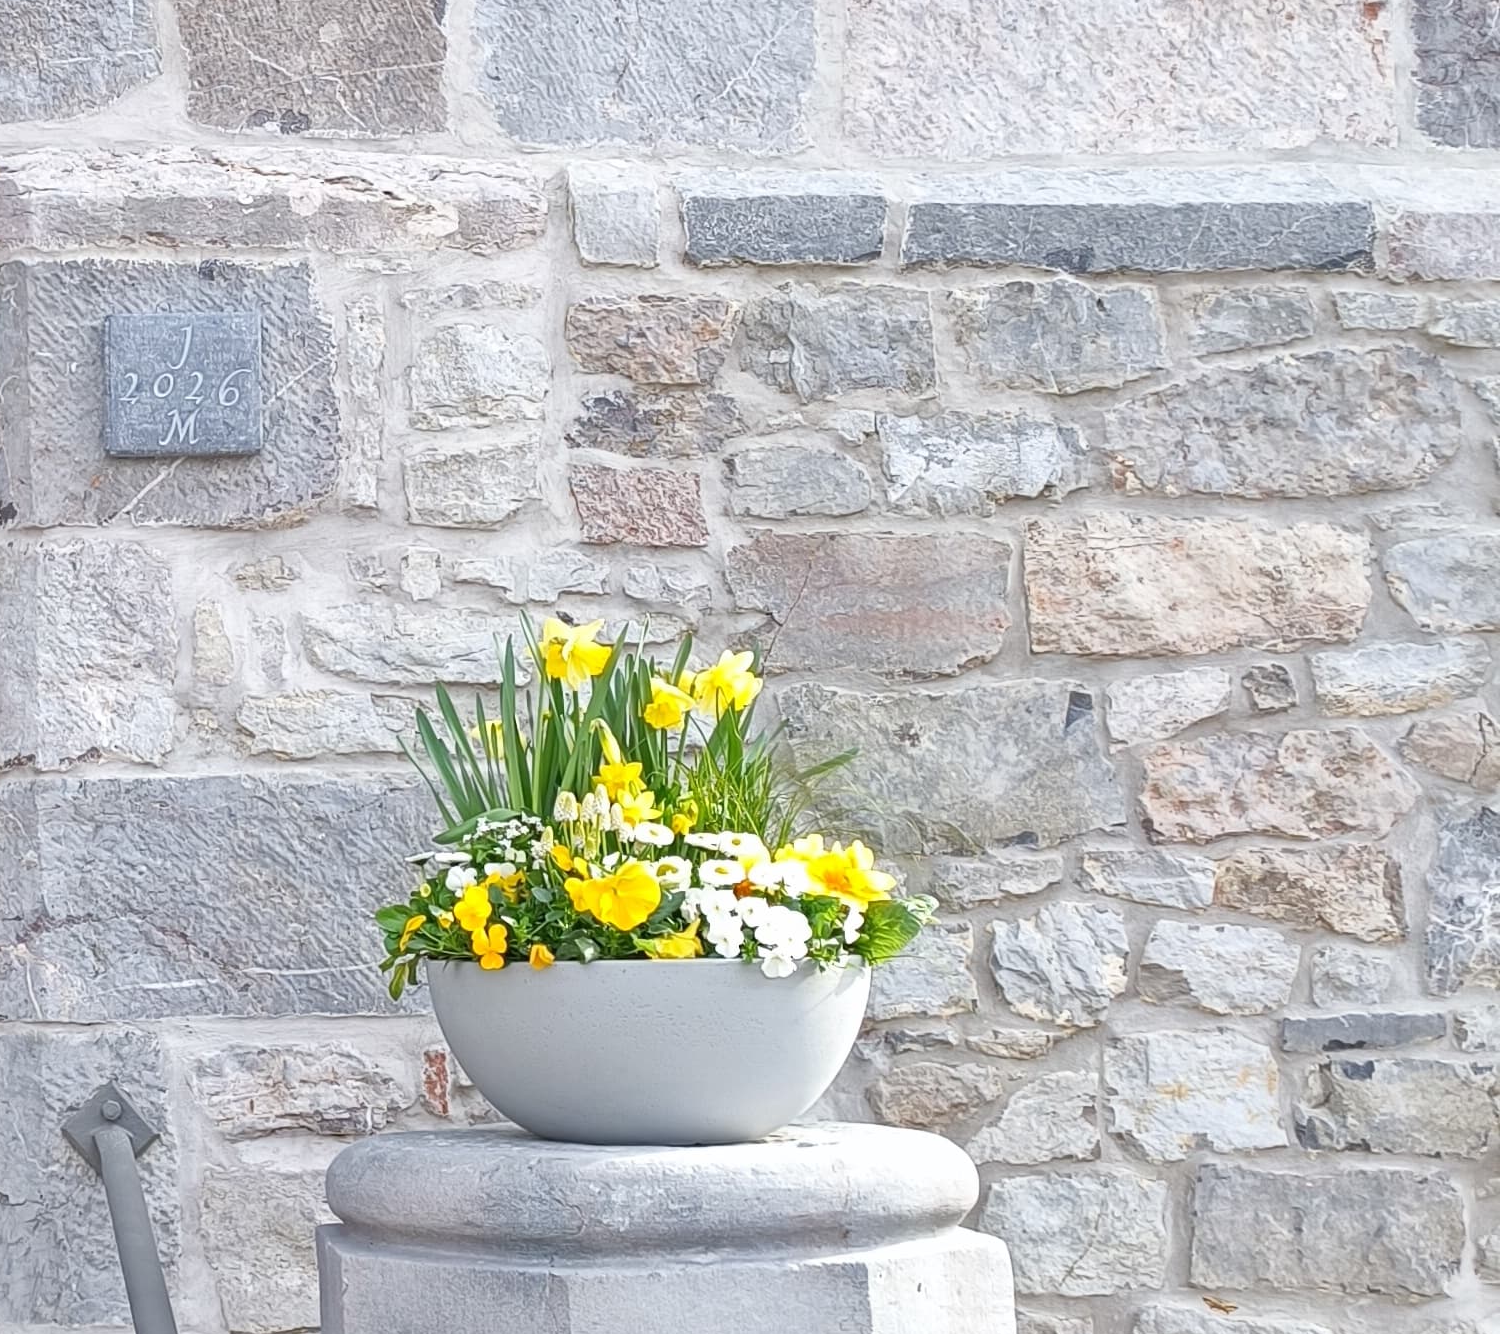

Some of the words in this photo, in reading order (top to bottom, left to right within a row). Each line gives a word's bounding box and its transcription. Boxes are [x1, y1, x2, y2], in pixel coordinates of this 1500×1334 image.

[167, 324, 194, 369] J
[119, 369, 253, 406] 2026
[158, 408, 203, 445] M
